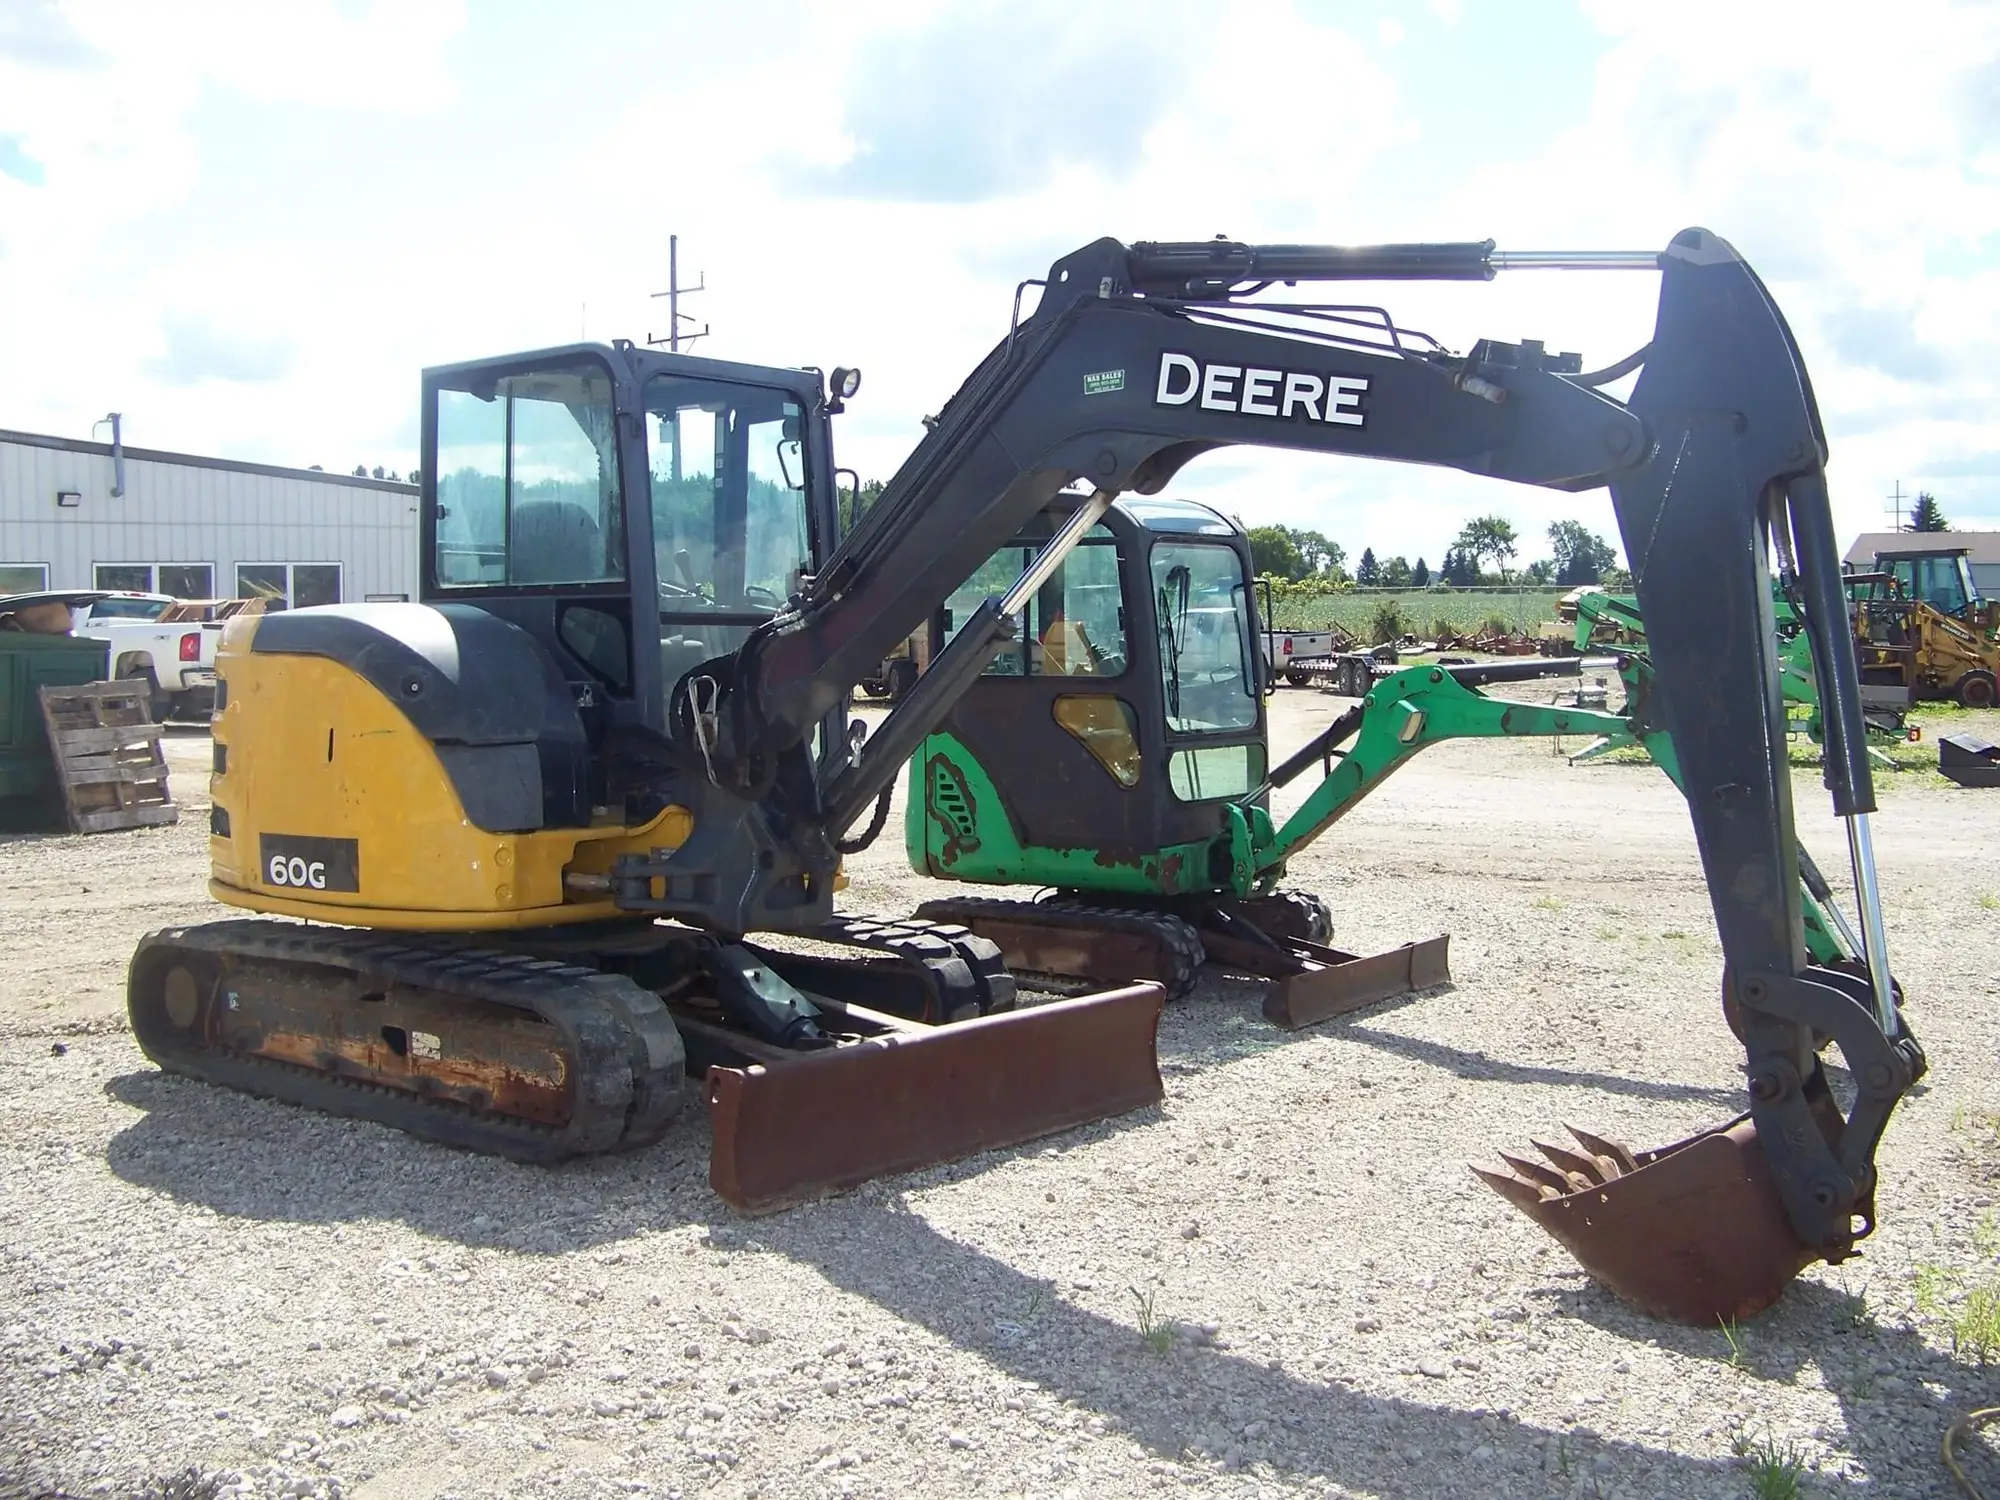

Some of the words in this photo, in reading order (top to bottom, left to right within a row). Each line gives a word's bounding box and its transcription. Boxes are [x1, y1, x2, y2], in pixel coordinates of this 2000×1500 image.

[1102, 371, 1122, 381] SALES
[1156, 352, 1368, 426] DEERE
[270, 855, 326, 889] 60G
